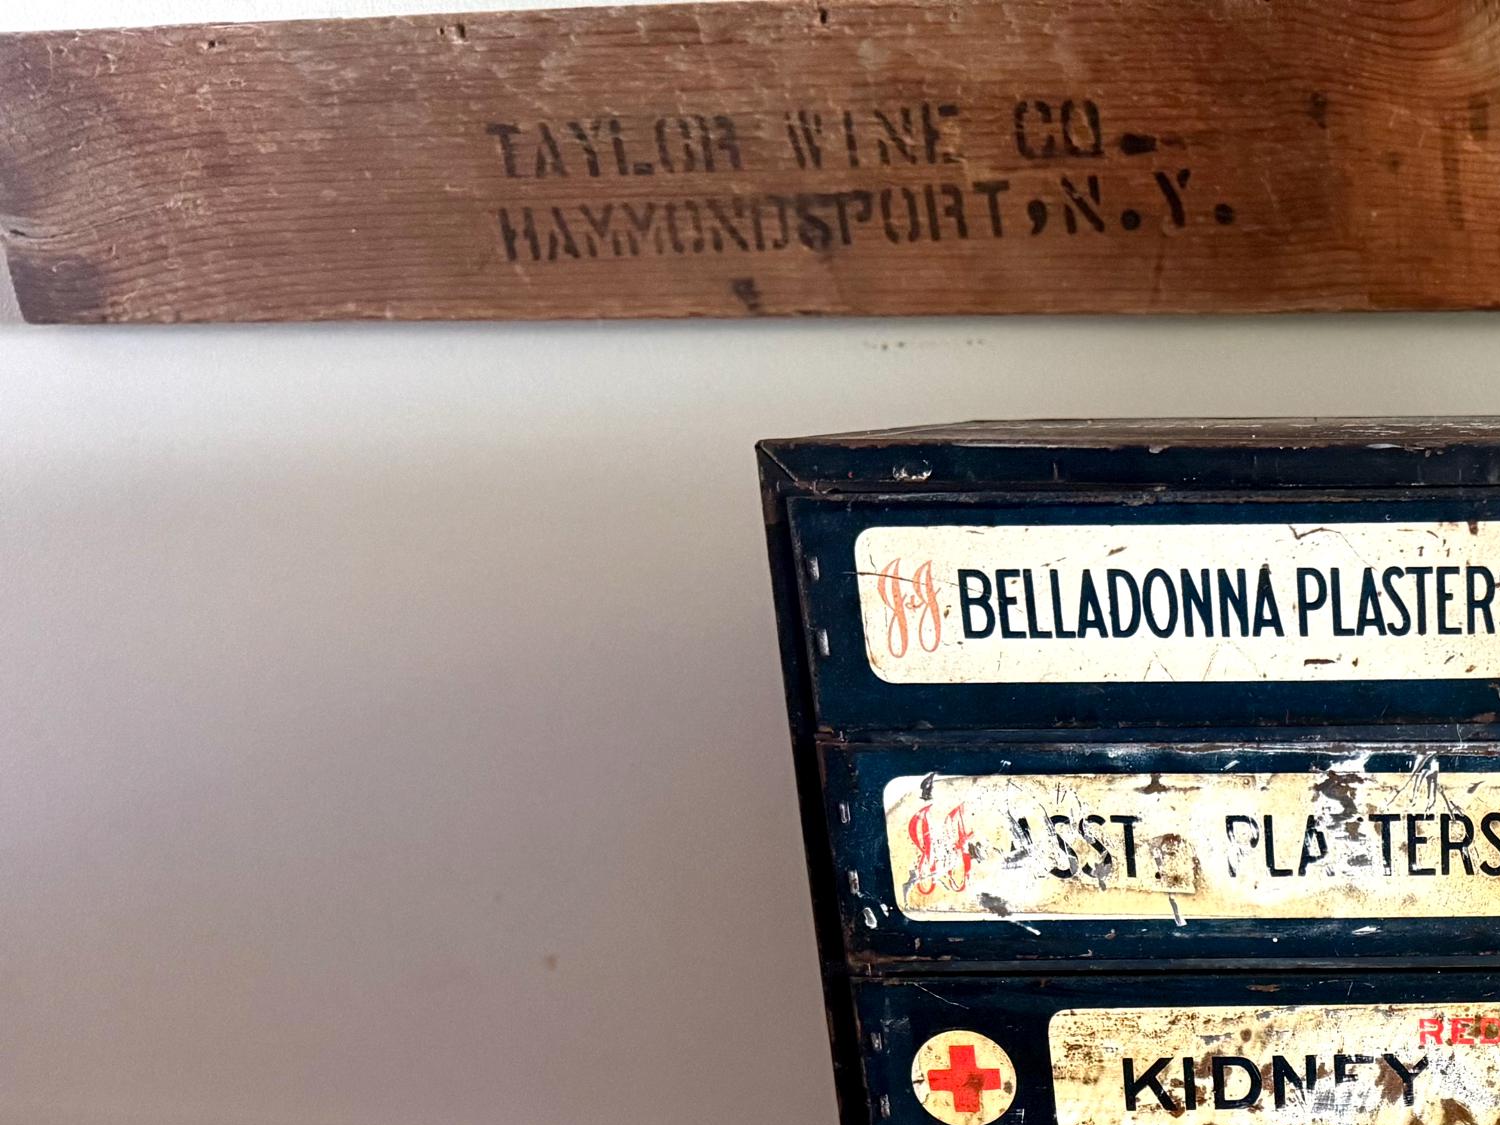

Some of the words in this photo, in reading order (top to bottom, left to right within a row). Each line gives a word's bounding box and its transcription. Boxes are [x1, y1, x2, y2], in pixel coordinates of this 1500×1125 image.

[486, 112, 743, 179] TAYLOR
[785, 102, 961, 169] WINE
[957, 567, 1284, 640] BELLADONNA
